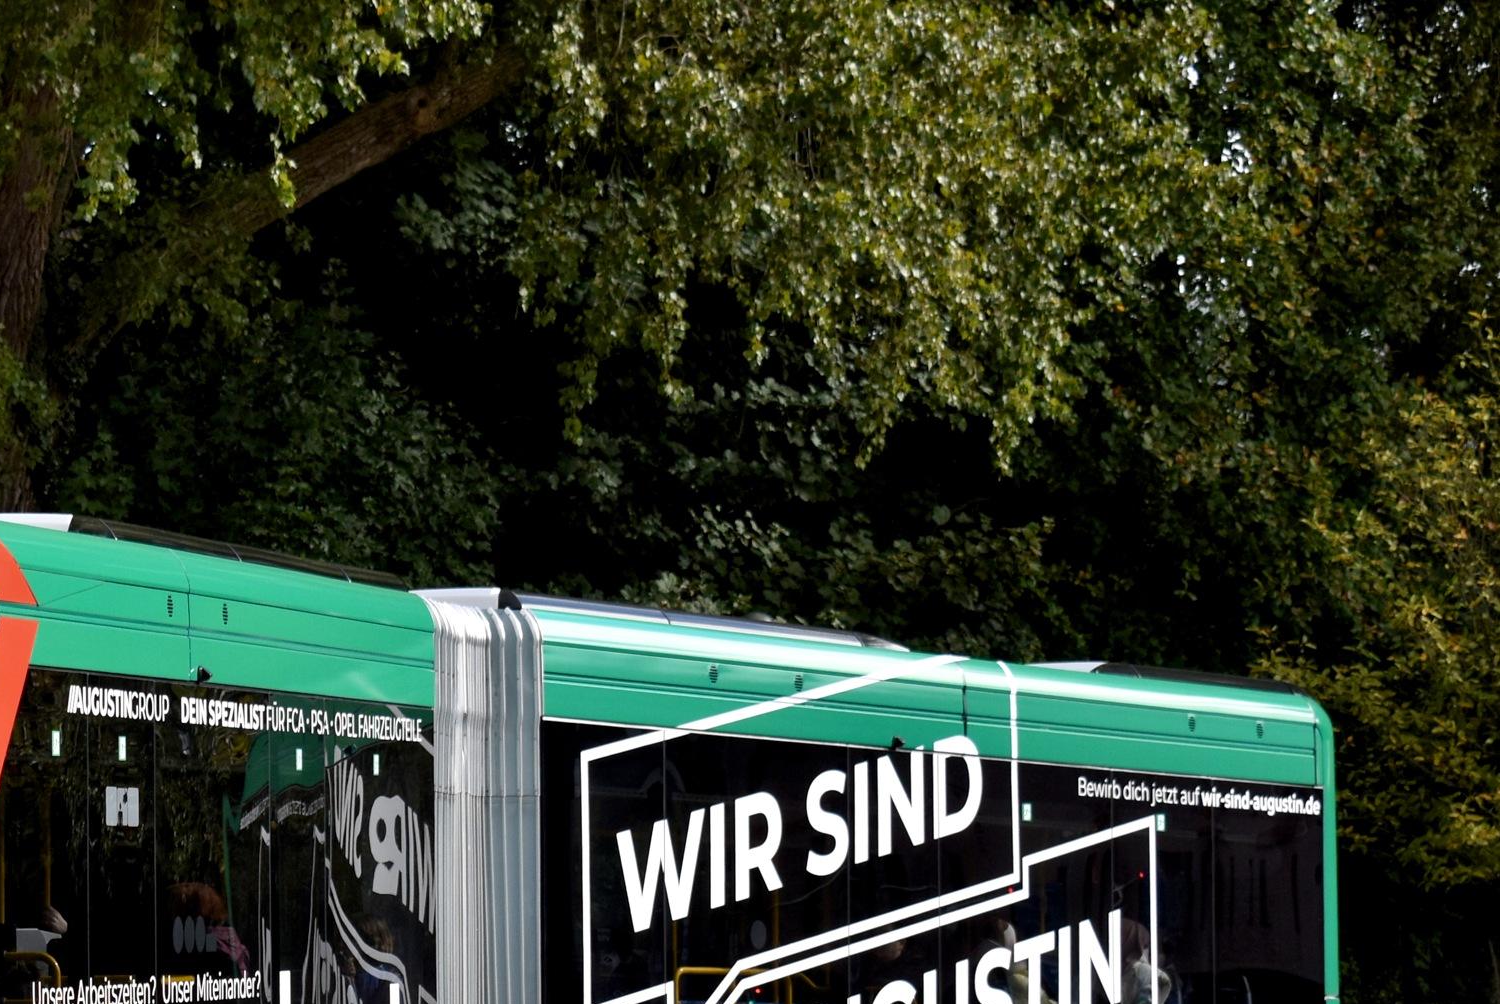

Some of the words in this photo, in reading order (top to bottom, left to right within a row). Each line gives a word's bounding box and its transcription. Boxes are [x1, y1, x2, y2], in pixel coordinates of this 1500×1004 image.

[180, 696, 207, 725] DEIN
[207, 699, 266, 731] SPEZIALIST
[266, 701, 285, 732] FÜR
[286, 708, 306, 733] FCA
[310, 709, 330, 736] PSA
[334, 711, 357, 738] OPEL
[358, 714, 423, 742] FAHRZEUGTEILE
[1077, 776, 1121, 800] Bewirb
[1122, 779, 1150, 802] dich
[1150, 783, 1179, 807] jetzt
[1180, 786, 1200, 806] auf
[1201, 787, 1321, 817] wir-sind-augustin.de
[616, 791, 784, 934] WIR
[805, 734, 984, 877] SIND
[161, 974, 196, 1004] Unser
[196, 970, 262, 1002] Miteinander?
